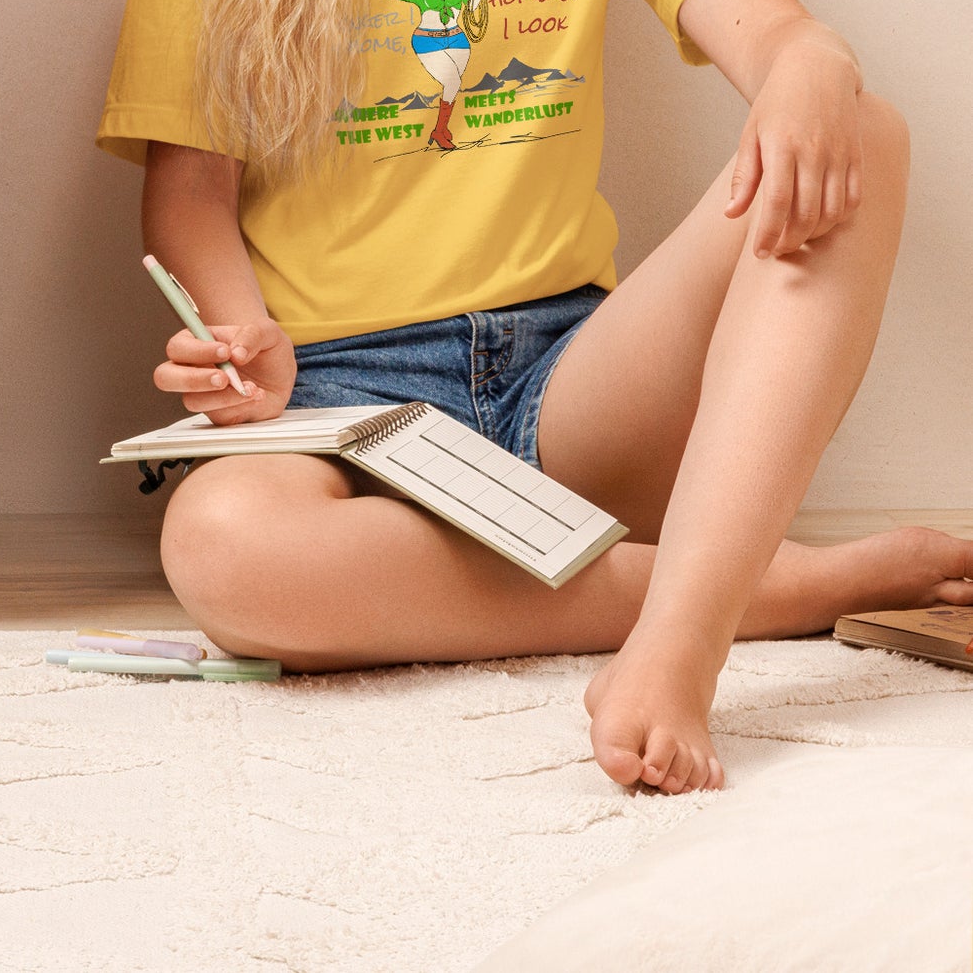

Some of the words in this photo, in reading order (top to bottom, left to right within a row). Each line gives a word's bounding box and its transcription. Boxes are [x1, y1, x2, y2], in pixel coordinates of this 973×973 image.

[503, 17, 509, 40] I
[518, 16, 569, 34] LOOK
[464, 89, 516, 109] MEETS
[464, 101, 574, 128] WANDERLUST
[336, 129, 372, 145] THE
[374, 123, 425, 142] WEST
